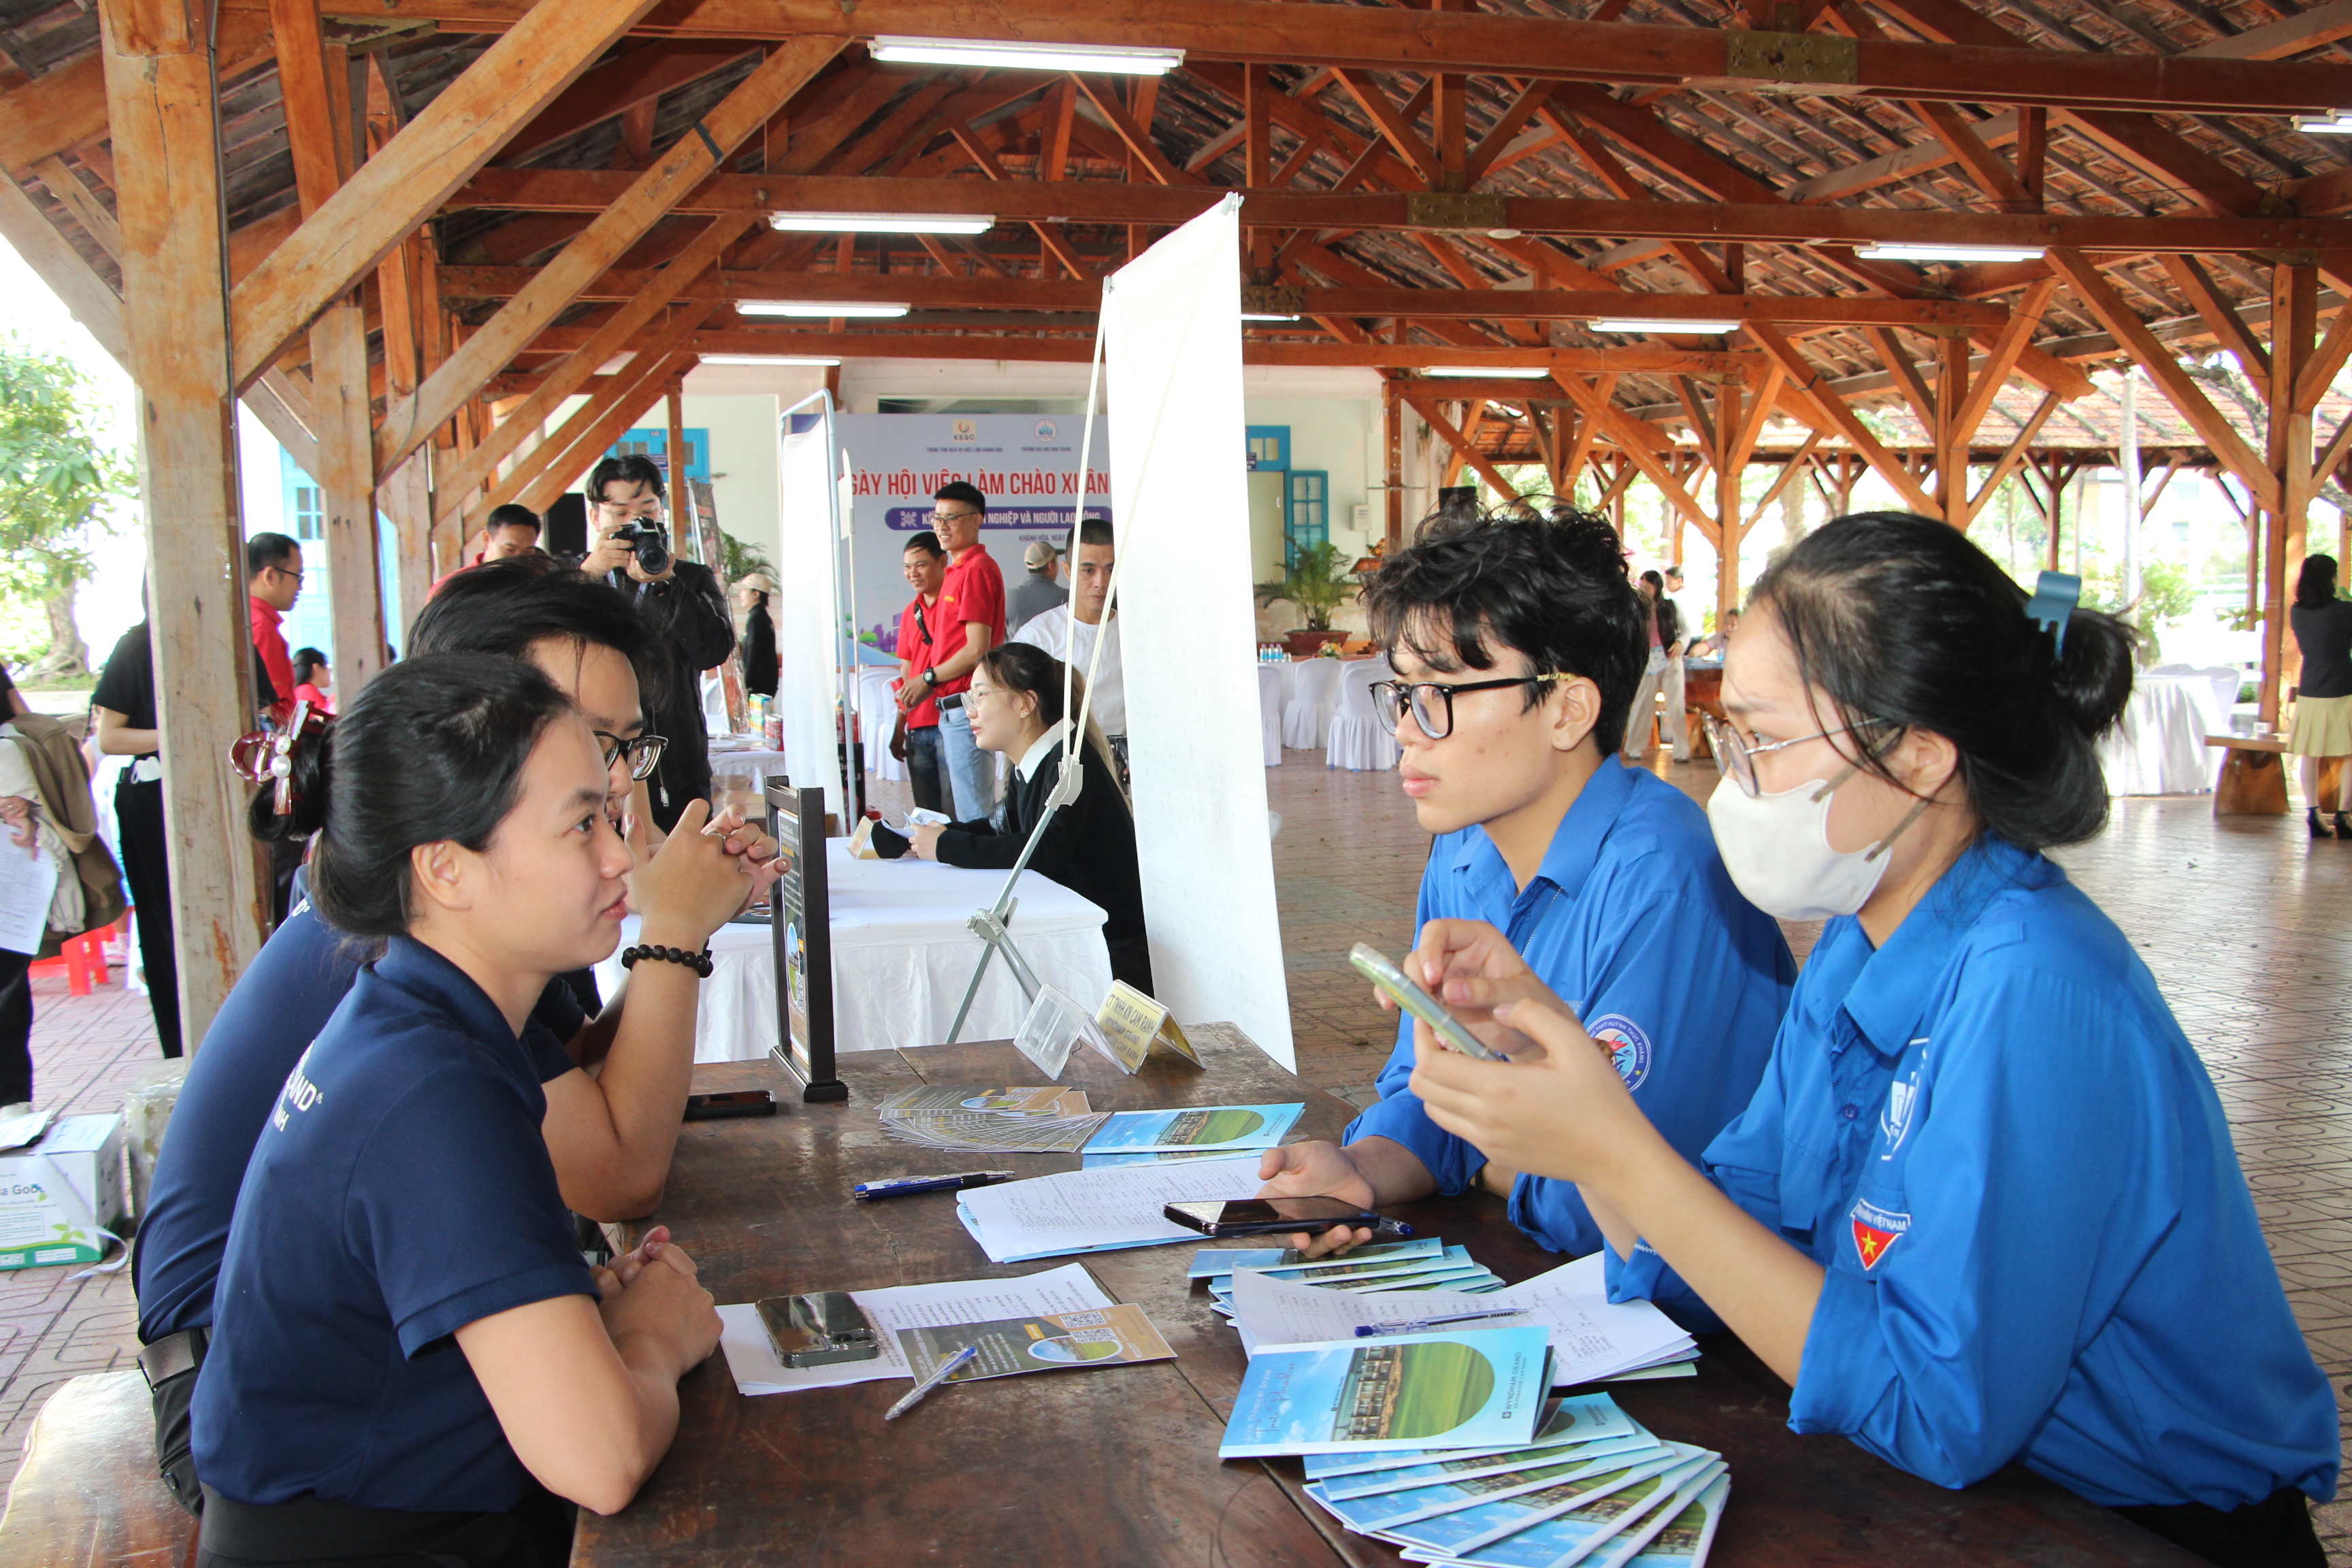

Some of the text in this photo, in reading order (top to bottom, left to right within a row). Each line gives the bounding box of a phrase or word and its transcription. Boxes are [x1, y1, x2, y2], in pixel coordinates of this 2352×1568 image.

[838, 469, 882, 495] GÀY
[887, 468, 917, 500] HỘI
[1010, 468, 1056, 495] CHÀO
[1061, 468, 1109, 495] XUÂN
[988, 510, 1019, 525] NGHIỆP
[1020, 510, 1032, 523] VÀ
[1033, 510, 1058, 523] NGƯỜI
[1060, 512, 1075, 523] LAO
[1019, 534, 1036, 542] KHÁNH
[1051, 534, 1065, 542] NGÀY
[1105, 994, 1157, 1036] CT TNHH KN CAM RANH
[1595, 1021, 1607, 1032] THPT
[1124, 1030, 1140, 1045] GRAND
[1116, 1041, 1129, 1054] CAM
[1126, 1047, 1140, 1062] RANH
[1504, 1352, 1522, 1411] WYNDHAM GRAND
[1242, 1369, 1272, 1441] Live Tropical Style
[1254, 1361, 1295, 1440] Taste Paradise
